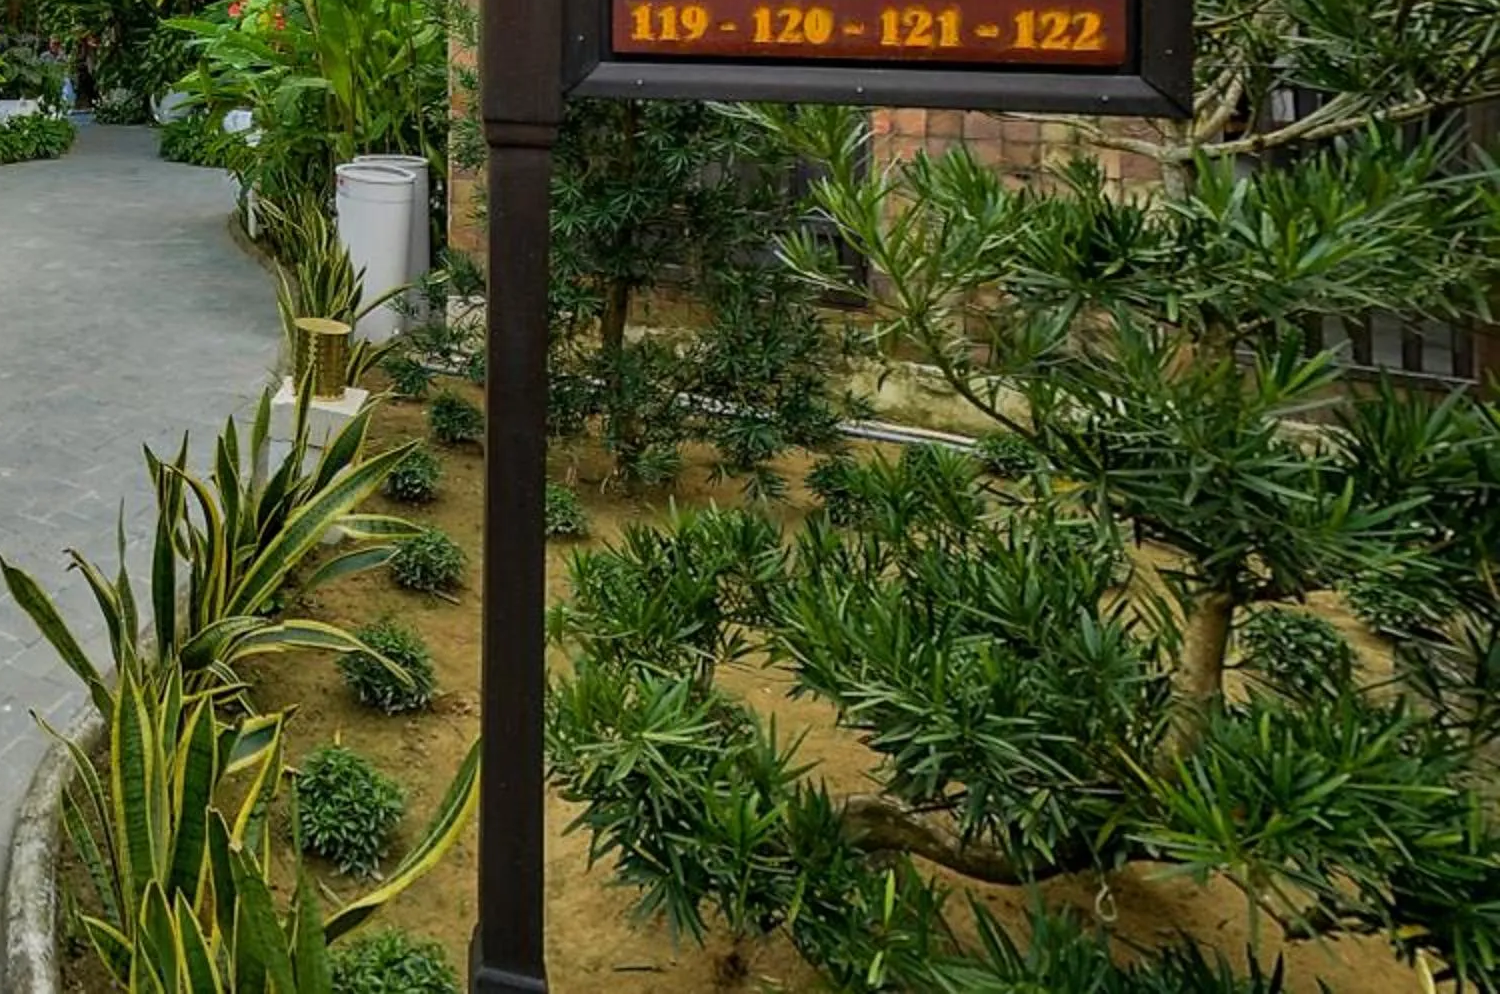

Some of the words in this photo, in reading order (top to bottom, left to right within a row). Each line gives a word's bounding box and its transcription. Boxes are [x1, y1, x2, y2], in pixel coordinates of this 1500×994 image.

[631, 3, 709, 42] 119
[752, 6, 834, 45] 120
[880, 6, 963, 47] 121
[1011, 9, 1104, 51] 122
